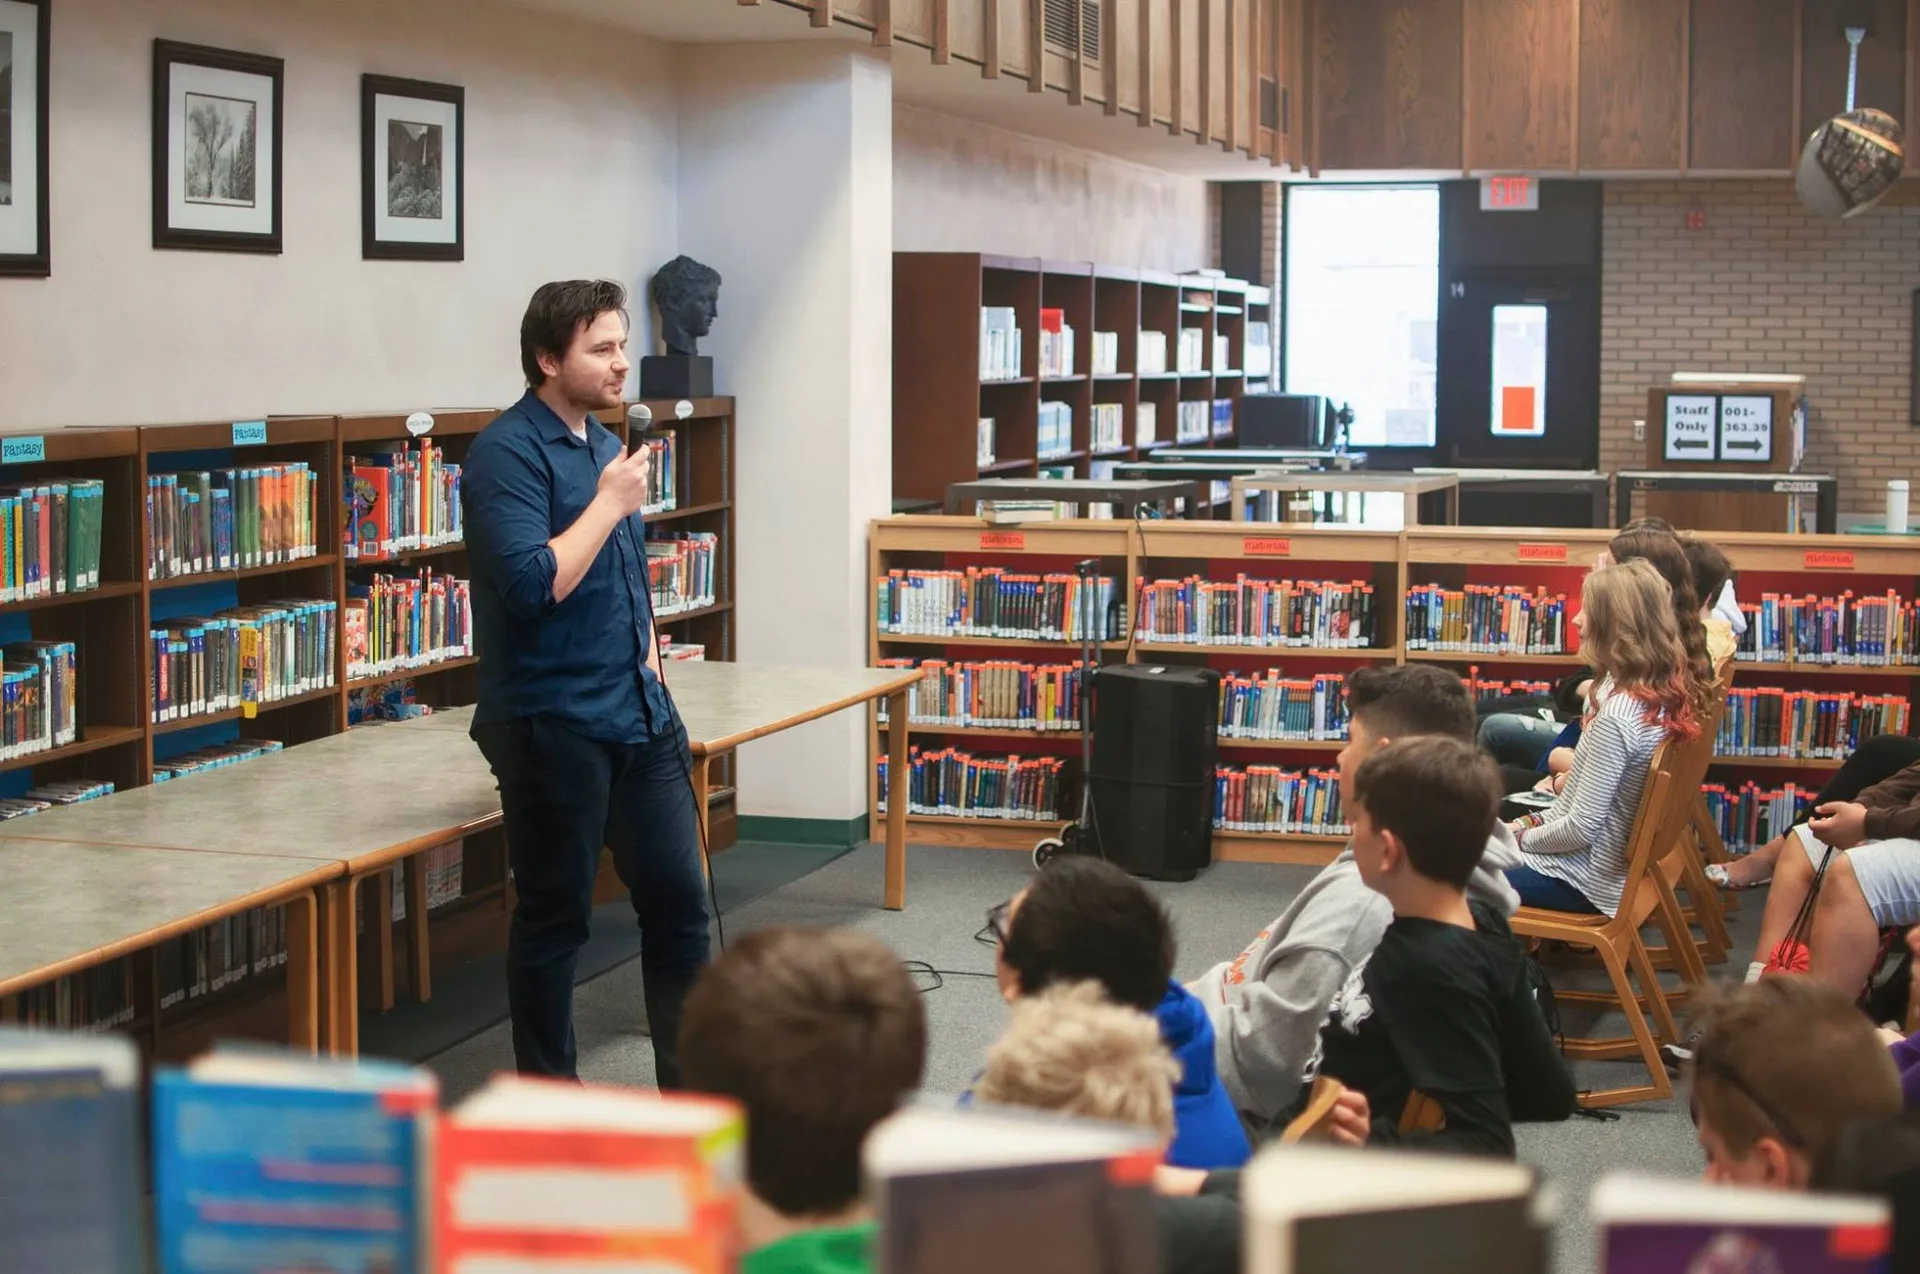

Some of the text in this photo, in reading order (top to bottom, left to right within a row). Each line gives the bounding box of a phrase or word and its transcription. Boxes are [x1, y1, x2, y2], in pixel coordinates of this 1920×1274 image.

[1490, 176, 1529, 207] EXIT
[1674, 405, 1709, 416] Staff
[1724, 407, 1756, 417] 001-
[1674, 421, 1707, 434] Only
[235, 428, 265, 440] Fantasy
[3, 443, 43, 458] Fantasy
